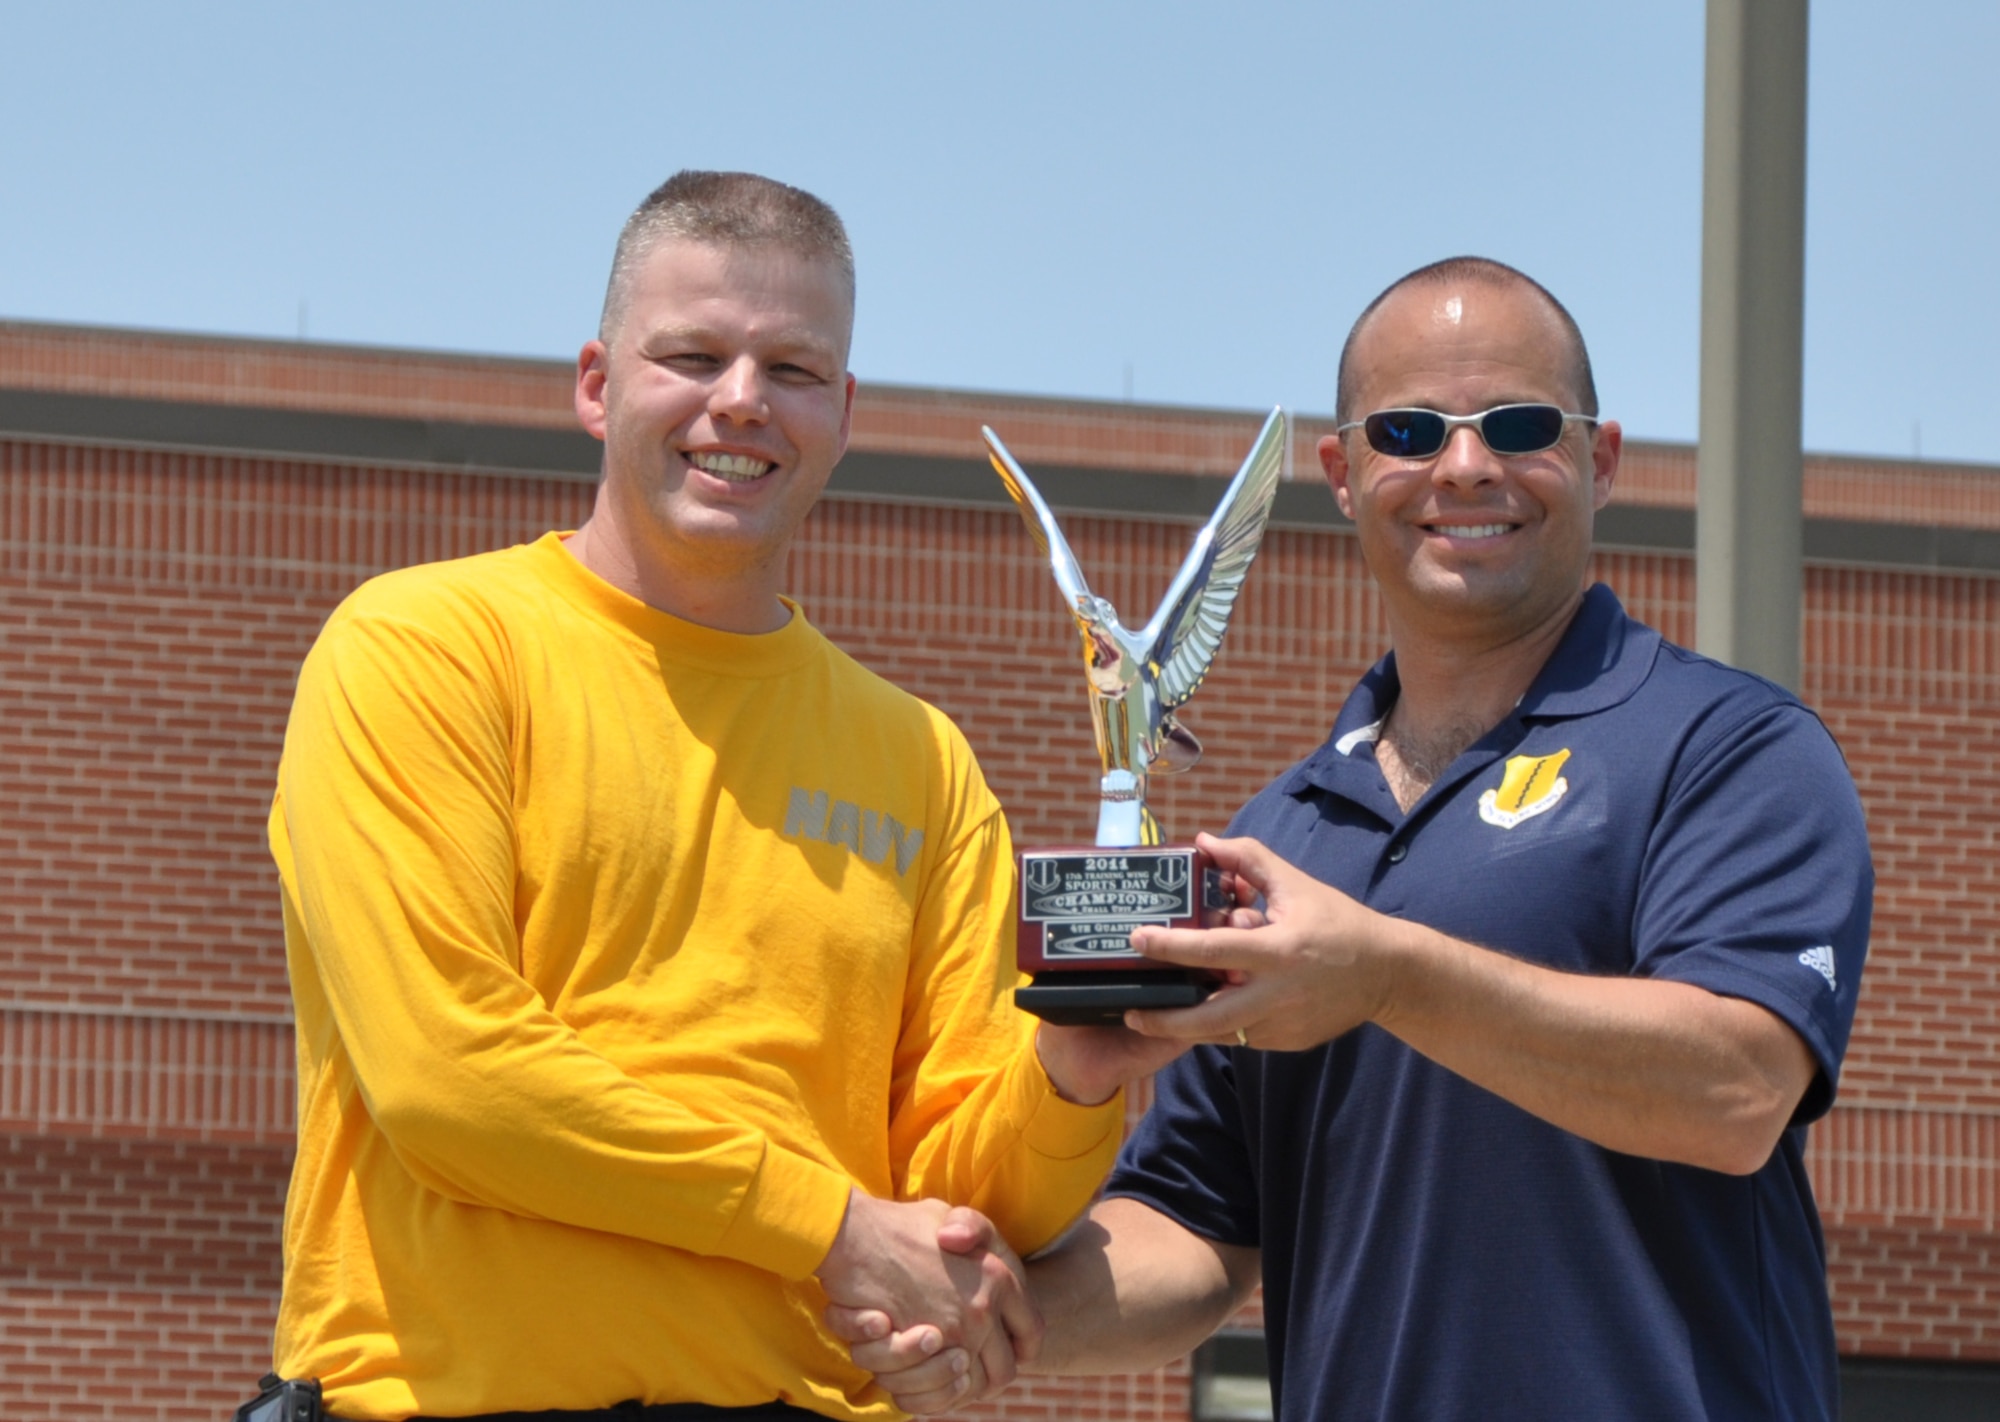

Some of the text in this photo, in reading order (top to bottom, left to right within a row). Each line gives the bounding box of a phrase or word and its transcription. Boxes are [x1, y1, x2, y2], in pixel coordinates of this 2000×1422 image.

[784, 785, 924, 877] NAVY
[1085, 858, 1129, 871] 2011
[1084, 871, 1124, 880] TRAINING
[1126, 870, 1149, 879] WING
[1065, 879, 1149, 891] SPORTS DAY
[1055, 893, 1159, 907] CHAMPIONS
